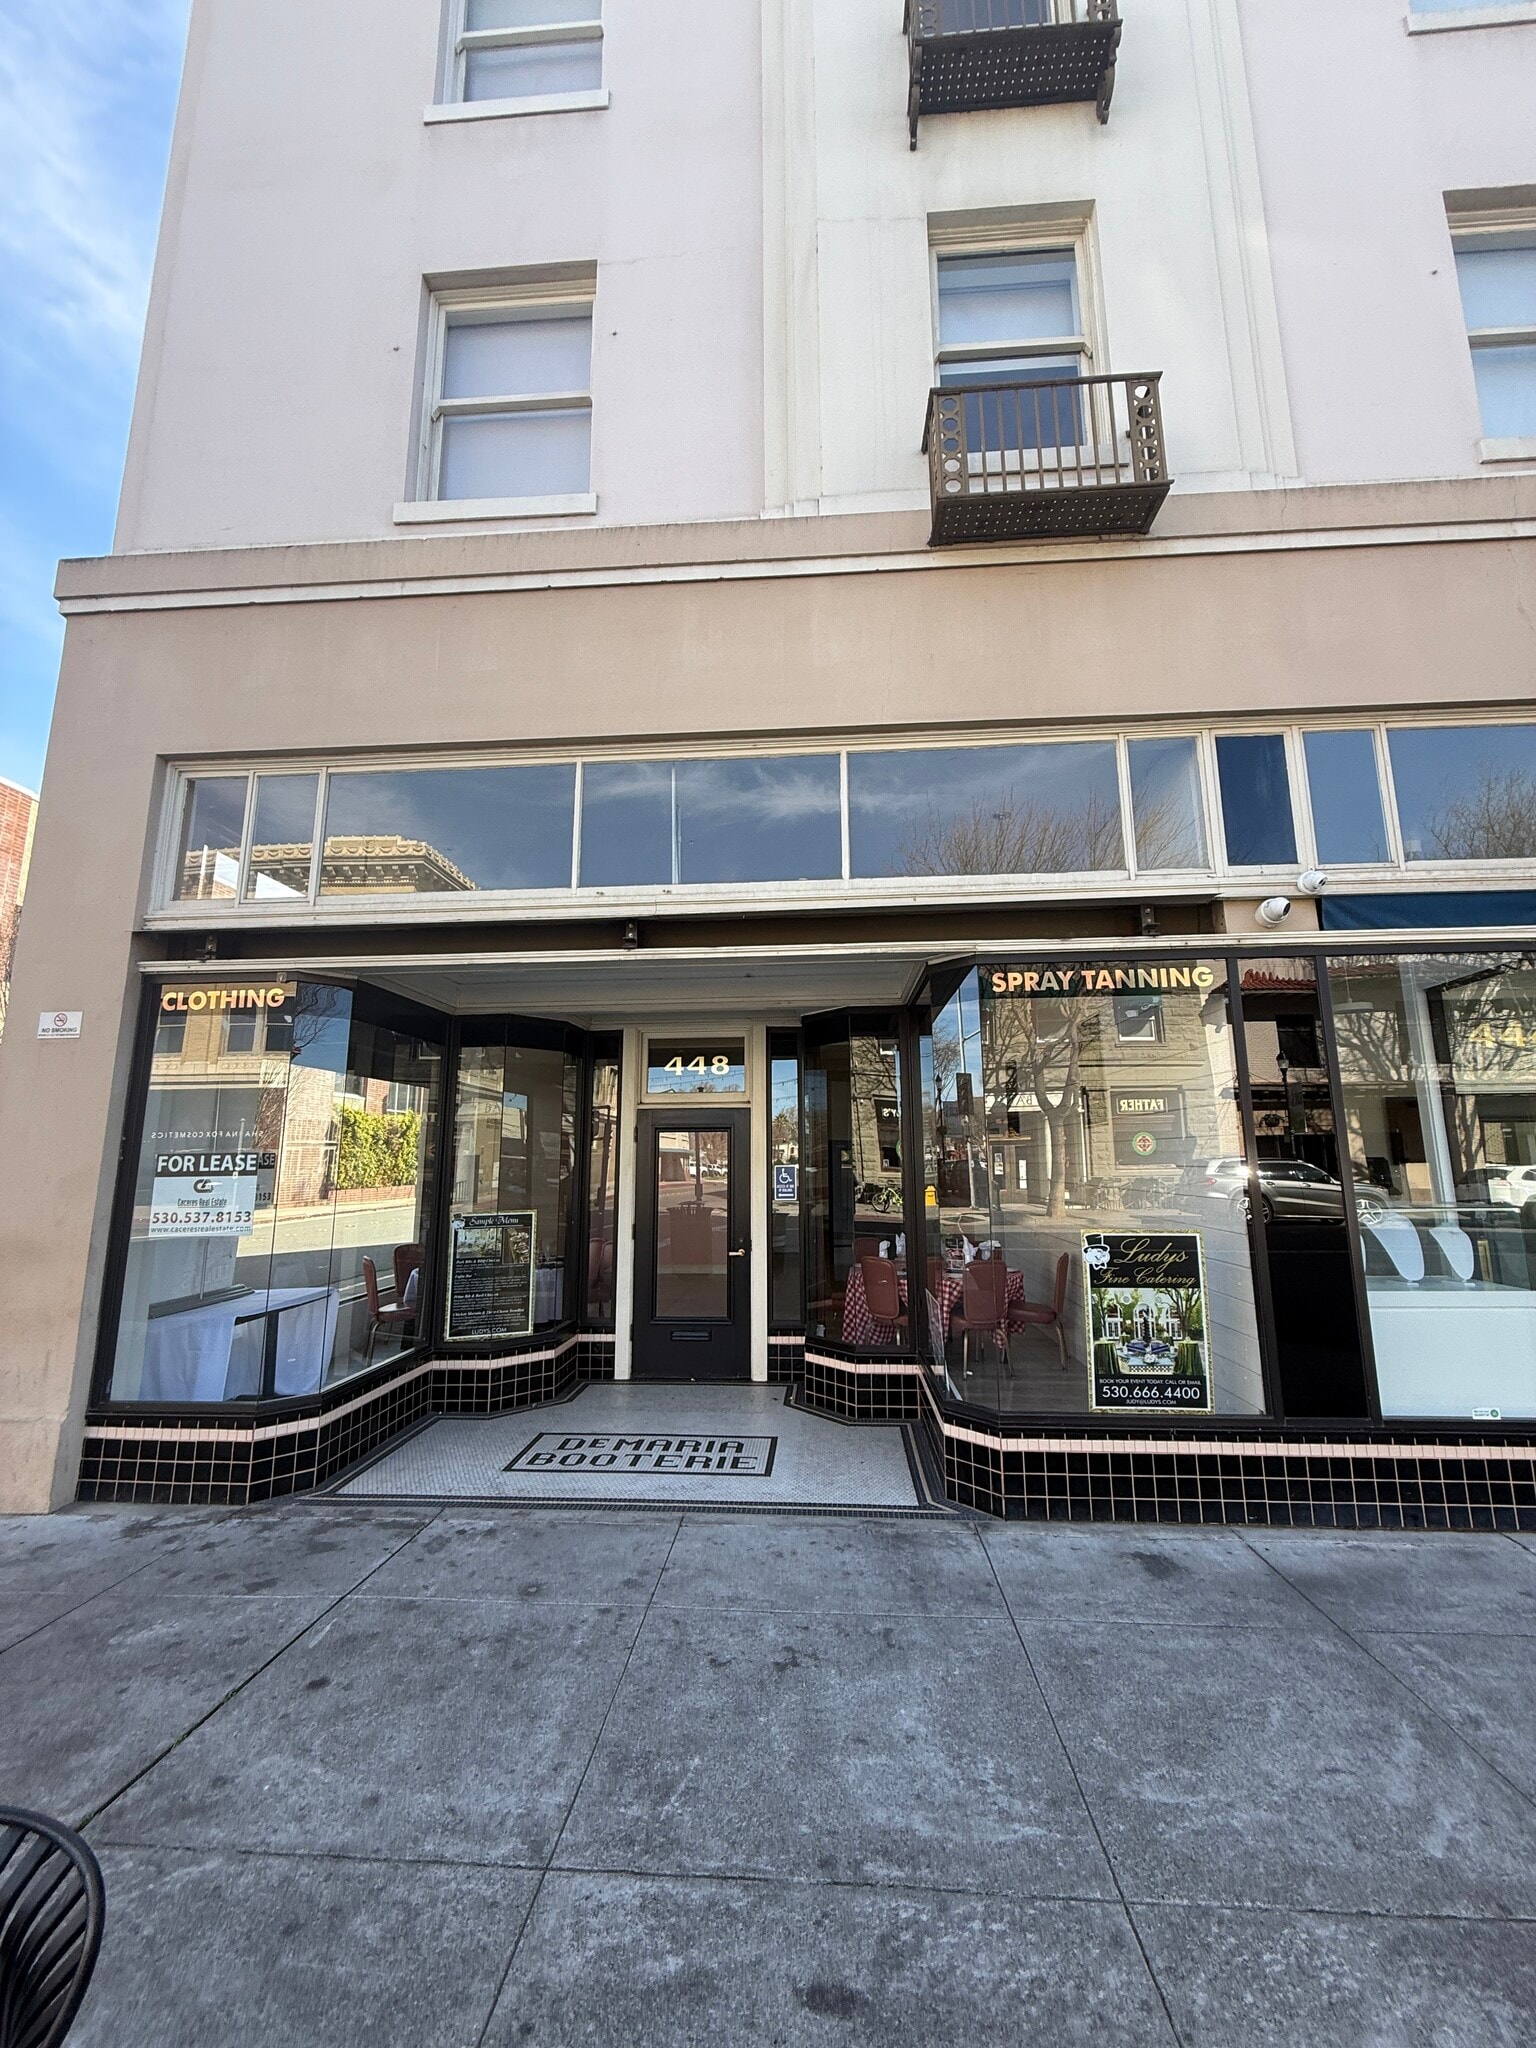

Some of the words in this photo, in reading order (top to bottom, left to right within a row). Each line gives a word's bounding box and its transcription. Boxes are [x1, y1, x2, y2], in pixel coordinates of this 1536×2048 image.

[992, 970, 1074, 993] SPRAY
[1081, 966, 1214, 991] TANNING
[162, 988, 285, 1012] CLOTHING
[663, 1055, 730, 1076] 448
[157, 1155, 196, 1173] FOR
[198, 1154, 258, 1172] LEASE
[199, 1197, 210, 1207] Real
[210, 1197, 227, 1207] Estate
[151, 1210, 252, 1224] 530.537.8153
[150, 1225, 251, 1234] www.caceresrealestate.com
[1113, 1238, 1189, 1273] Ludys
[1093, 1266, 1130, 1285] Fine
[1133, 1266, 1196, 1288] Catering
[1102, 1385, 1200, 1400] 530.666.4400
[525, 1452, 758, 1470] BOOTERIE
